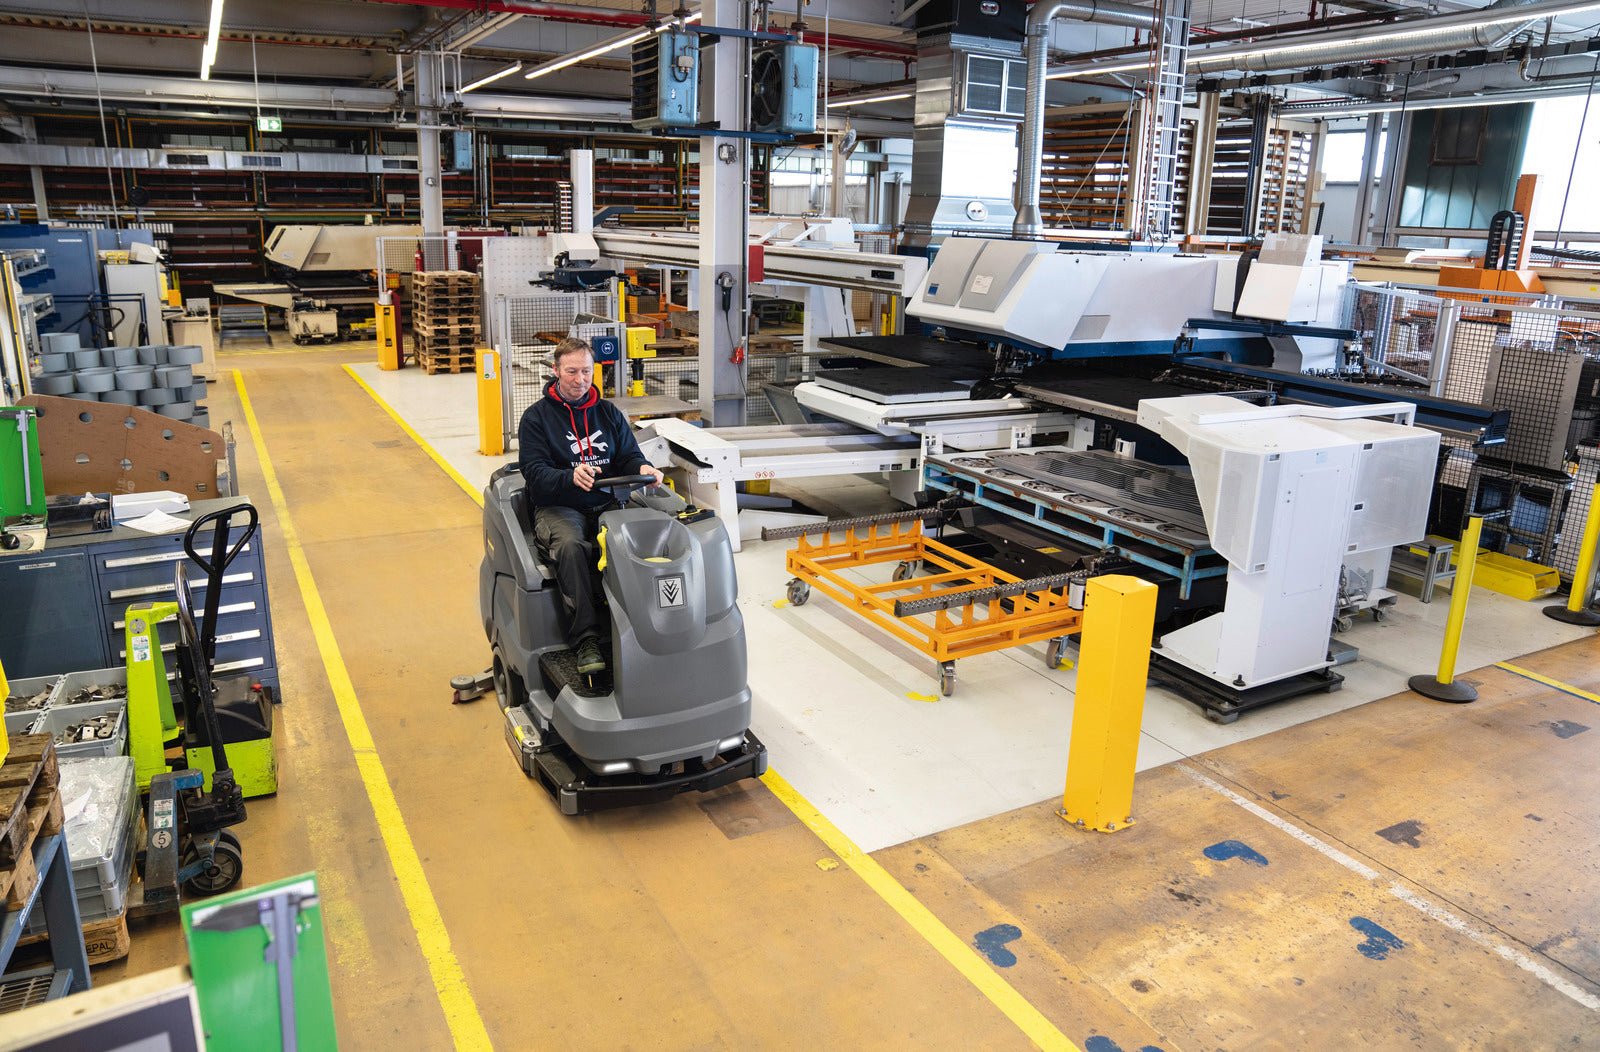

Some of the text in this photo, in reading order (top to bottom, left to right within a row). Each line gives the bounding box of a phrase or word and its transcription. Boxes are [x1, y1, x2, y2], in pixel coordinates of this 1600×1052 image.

[677, 103, 683, 114] 2
[798, 112, 803, 122] 2
[571, 459, 610, 467] VABUNDEN
[158, 833, 166, 845] 5
[85, 941, 111, 953] EPAL
